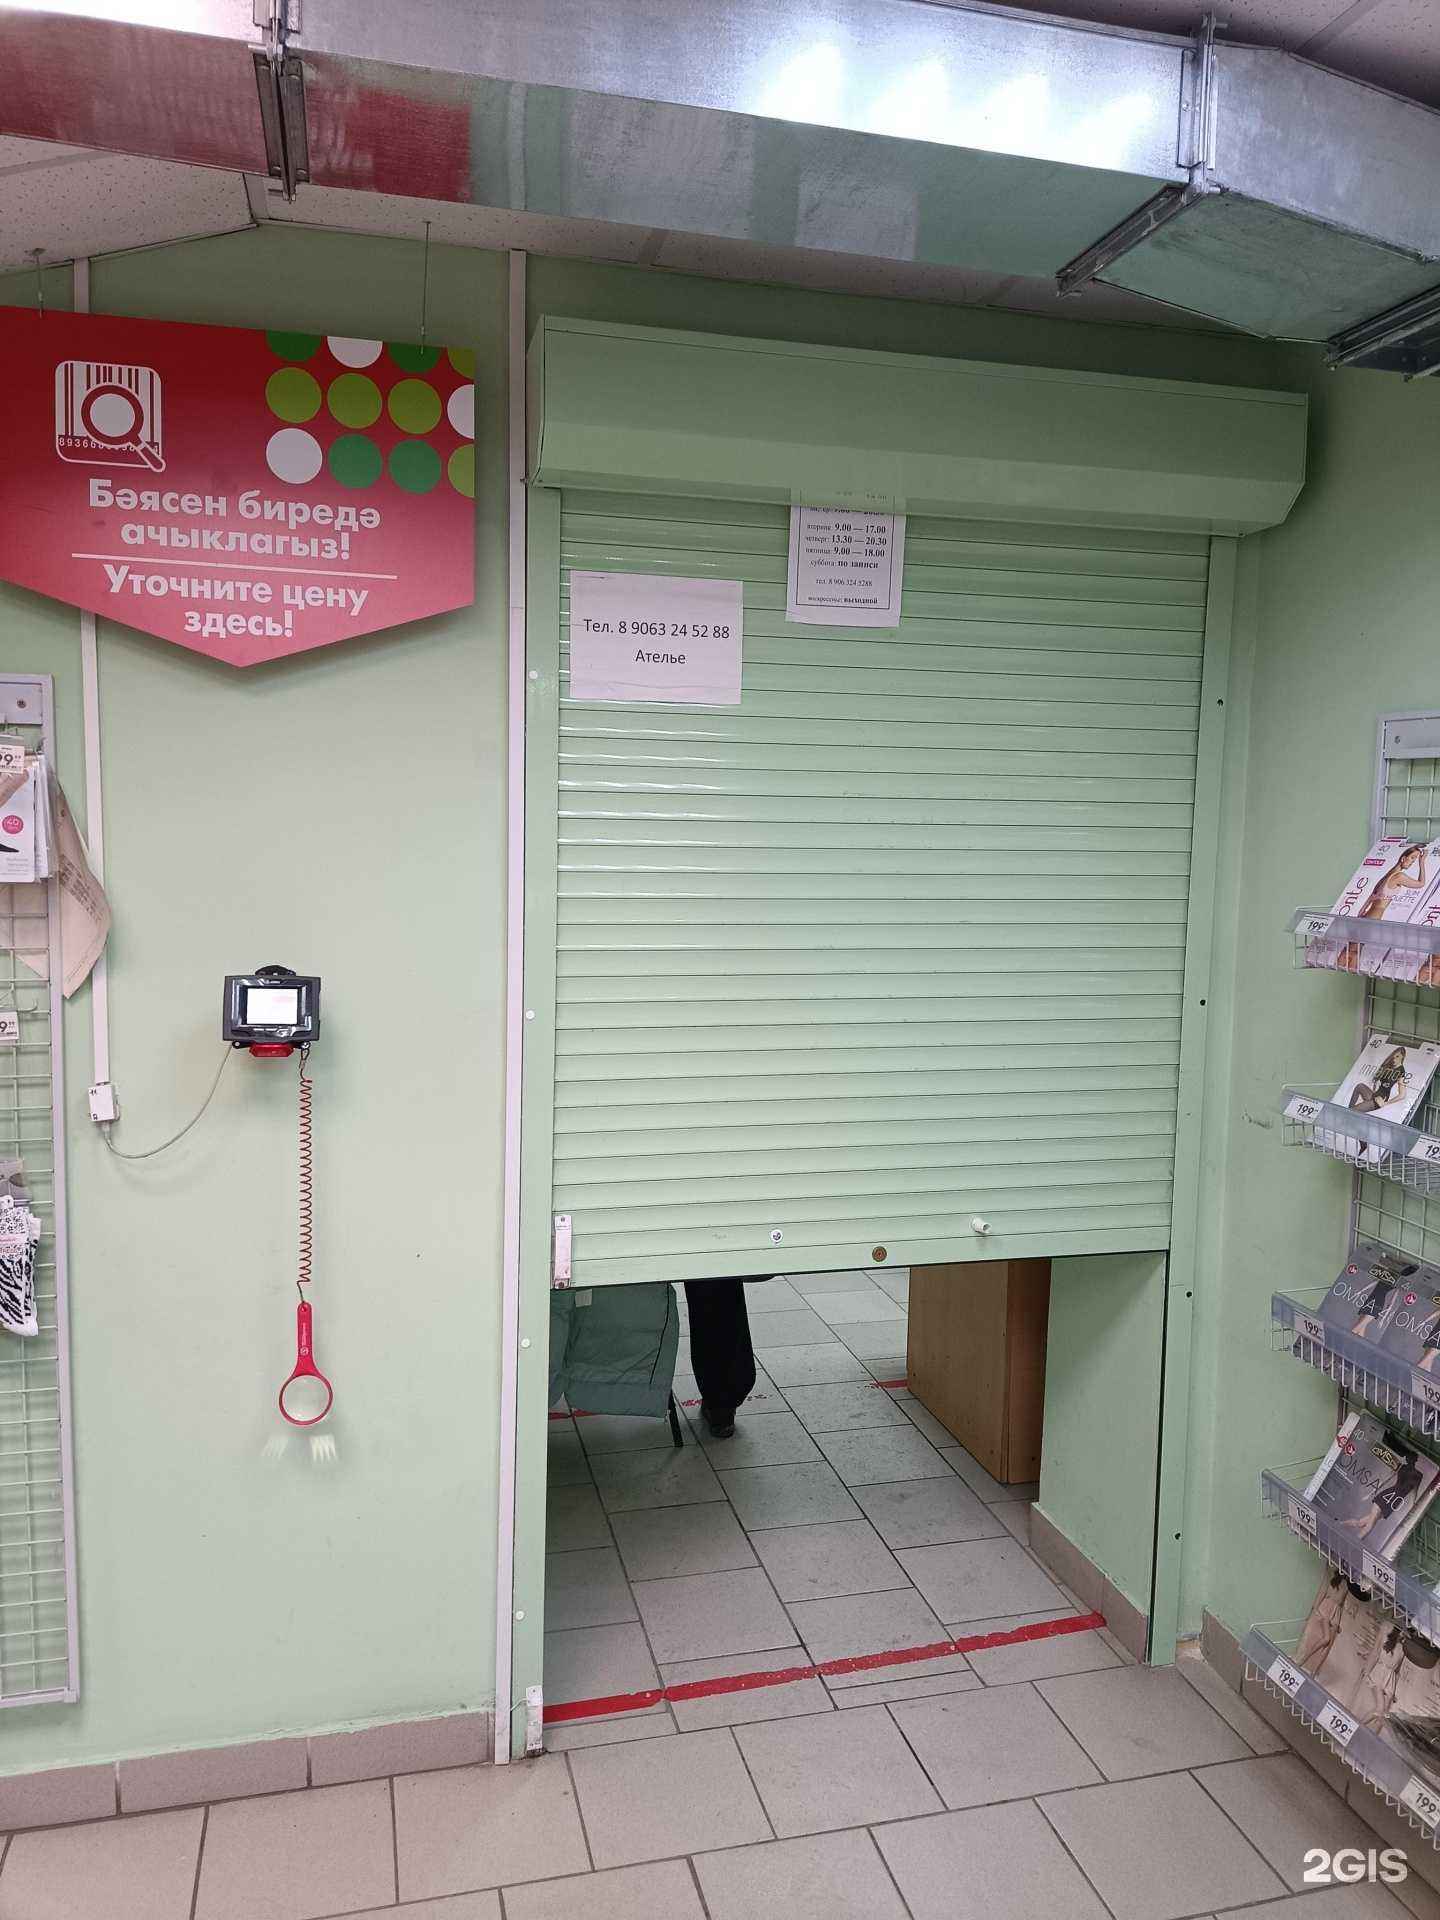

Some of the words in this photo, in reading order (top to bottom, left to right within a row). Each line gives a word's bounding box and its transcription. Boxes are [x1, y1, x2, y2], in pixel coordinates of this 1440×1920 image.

[89, 477, 228, 517] Бәясен
[238, 489, 381, 532] биредә
[834, 522, 852, 532] 9.00
[865, 525, 886, 534] 17.00
[121, 521, 351, 560] ачыклагыз!
[832, 534, 852, 544] 13.30
[866, 536, 887, 545] 20.30
[834, 546, 851, 555] 9.00
[864, 548, 885, 557] 18.00
[103, 563, 273, 603] Уточните
[283, 584, 369, 616] цену
[184, 610, 293, 638] здесь!
[583, 618, 614, 633] Тел.
[618, 620, 627, 634] 8
[631, 621, 666, 636] 9063
[671, 623, 688, 637] 24
[692, 625, 709, 638] 52
[712, 625, 730, 639] 88
[635, 649, 686, 664] Ателье
[1338, 877, 1369, 917] onte
[1333, 1281, 1376, 1313] OMSA
[1382, 1491, 1405, 1512] 40
[1296, 1506, 1311, 1524] 199
[1372, 1564, 1390, 1584] 199
[1278, 1669, 1296, 1687] 199
[1330, 1715, 1348, 1734] 199
[1416, 1792, 1437, 1814] 199
